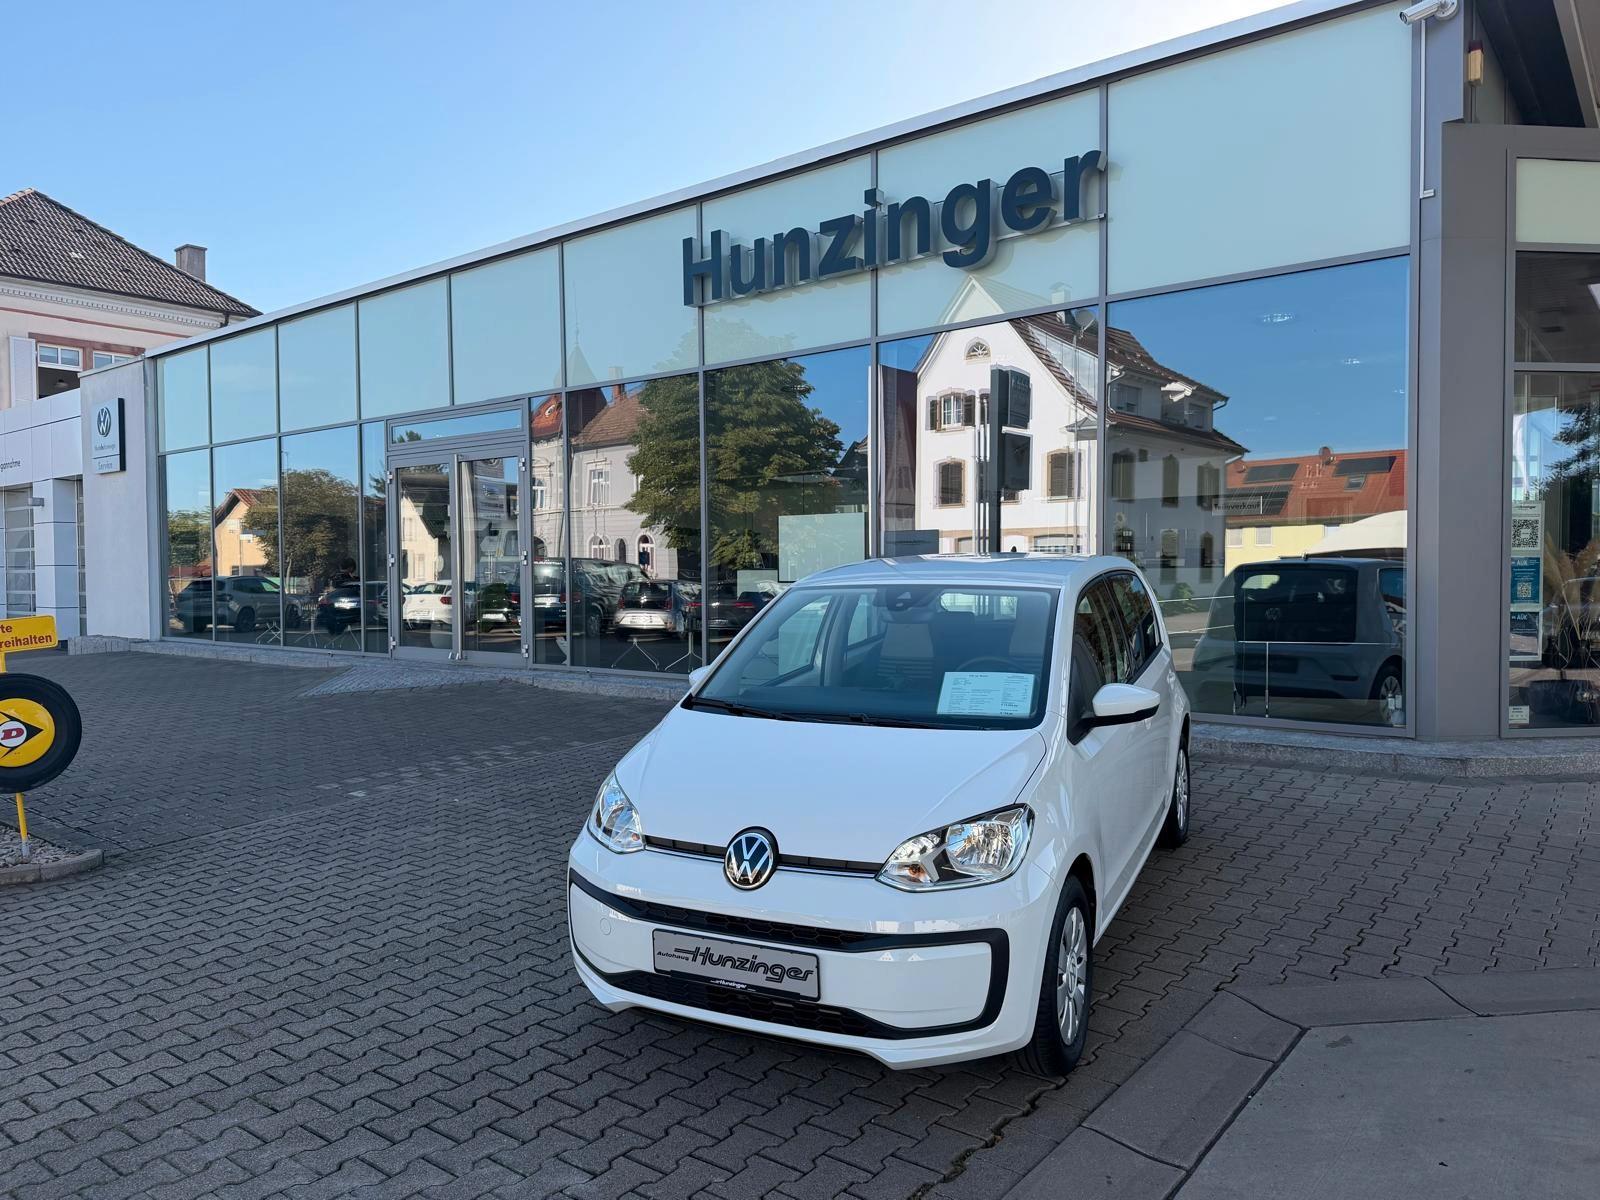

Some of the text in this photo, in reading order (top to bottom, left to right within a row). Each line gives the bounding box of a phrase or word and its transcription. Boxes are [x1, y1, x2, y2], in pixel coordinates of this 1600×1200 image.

[683, 150, 1106, 307] Hunzinger
[1, 727, 24, 740] D
[657, 947, 814, 983] Autohaus Hunzinger
